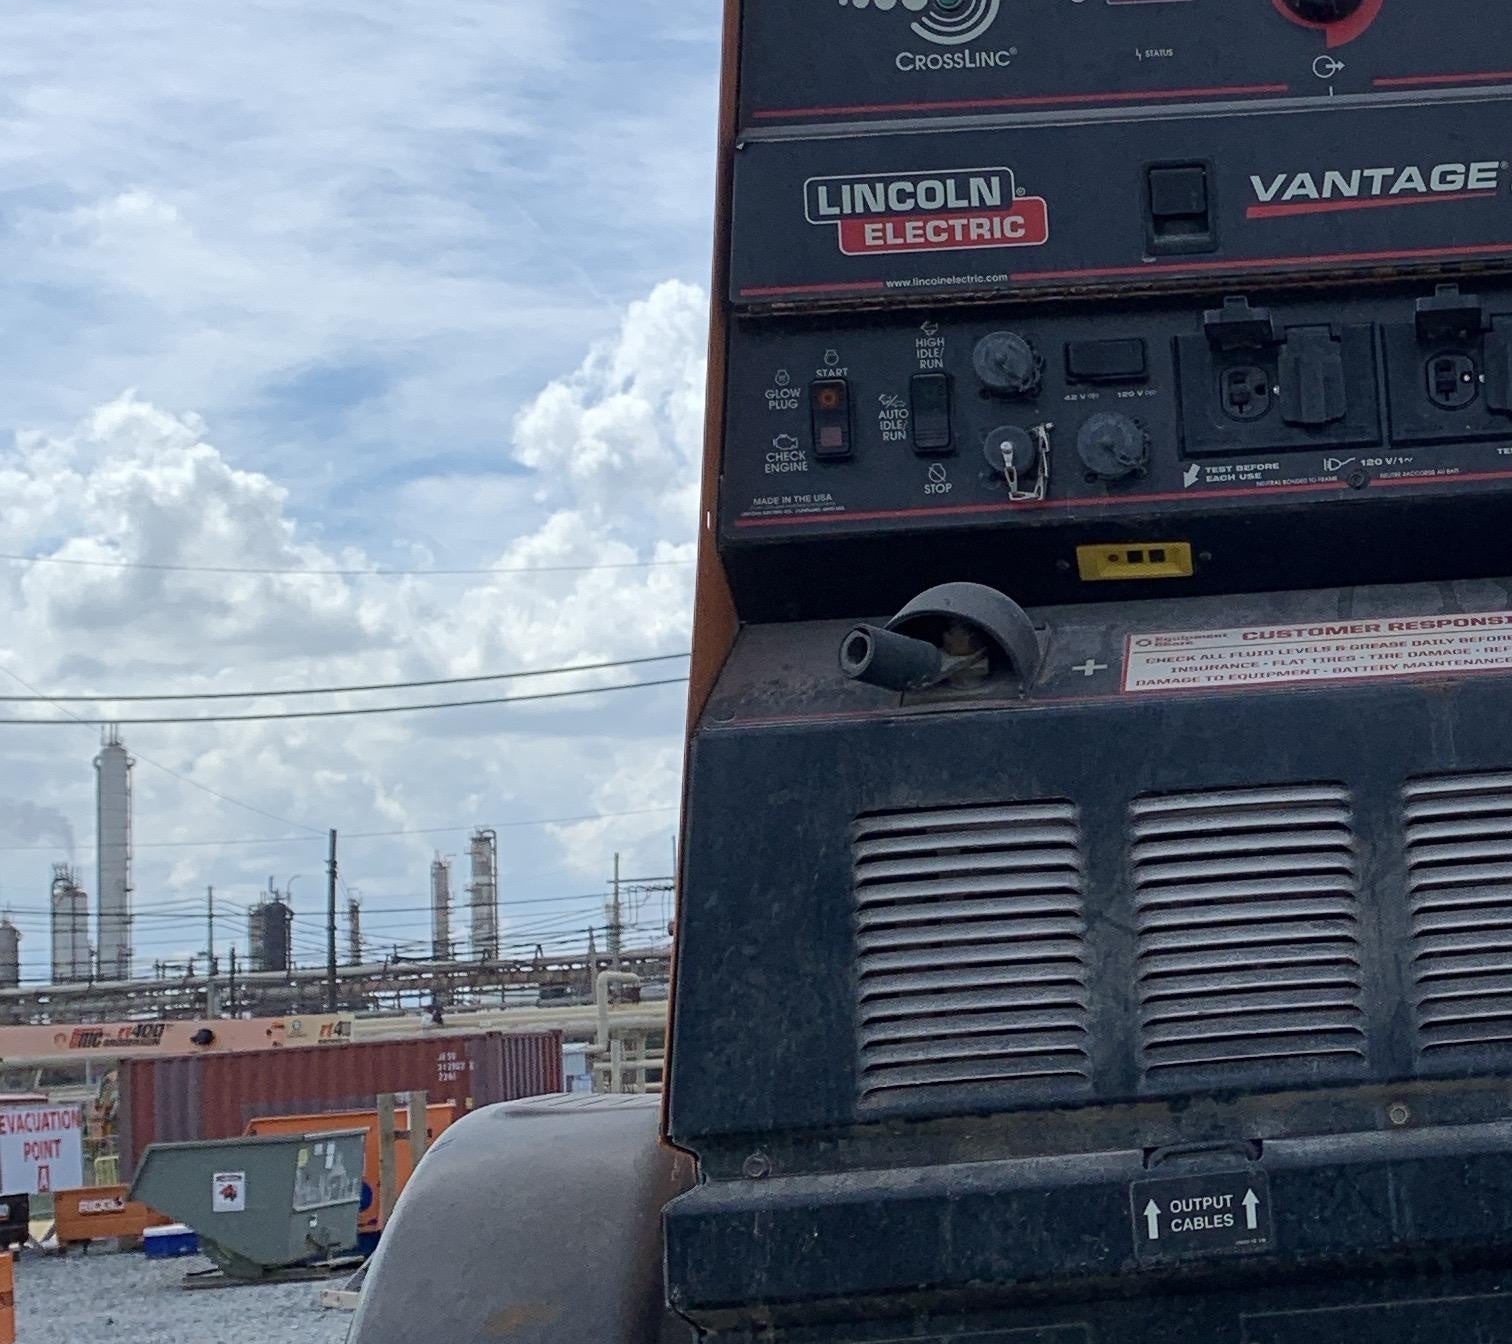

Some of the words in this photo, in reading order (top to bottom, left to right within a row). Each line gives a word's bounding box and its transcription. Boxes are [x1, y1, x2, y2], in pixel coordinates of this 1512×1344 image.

[1144, 48, 1174, 58] STATUS
[1249, 160, 1500, 202] VANTAGE
[817, 176, 1001, 216] LINCOLN
[864, 215, 1026, 246] ELECTRIC
[915, 338, 945, 349] HIGH
[916, 347, 944, 360] IDLE/
[919, 358, 944, 369] RUN
[816, 367, 849, 378] START
[764, 388, 801, 400] GLOW
[768, 399, 799, 410] PLUG
[878, 409, 909, 420] AUTO
[882, 430, 907, 441] RUN
[765, 450, 806, 463] CHECK
[1360, 458, 1383, 467] 120
[764, 461, 808, 474] ENGINE
[1205, 465, 1233, 473] TEST
[1235, 462, 1280, 472] BEFORE
[1206, 473, 1236, 482] EACH
[1239, 472, 1263, 481] USE
[924, 483, 953, 495] STOP
[753, 496, 780, 505] MADE
[781, 496, 792, 504] IN
[794, 494, 811, 503] THE
[814, 493, 833, 502] USA
[1242, 622, 1381, 641] CUSTOMER
[1154, 632, 1229, 644] Equipment
[1146, 655, 1198, 664] CHECK
[1199, 653, 1227, 661] ALL
[1229, 649, 1274, 659] FLUID
[1278, 646, 1332, 656] LEVELS
[1349, 640, 1407, 651] GREASE
[1411, 637, 1455, 647] DAILY
[1170, 661, 1261, 674] INSURANCE
[1272, 658, 1305, 667] FLAT
[1311, 655, 1357, 664] TIRES
[1367, 652, 1403, 661] TIRE
[1407, 647, 1472, 658] DAMAGE
[1135, 674, 1201, 686] DAMAGE
[1206, 673, 1225, 682] TO
[1228, 668, 1319, 681] EQUIPMENT
[1332, 662, 1399, 673] BATTERY
[0, 1109, 82, 1136] EVACUATION
[24, 1138, 62, 1162] POINT
[1169, 1194, 1234, 1214] OUTPUT
[1170, 1213, 1234, 1233] CABLES
